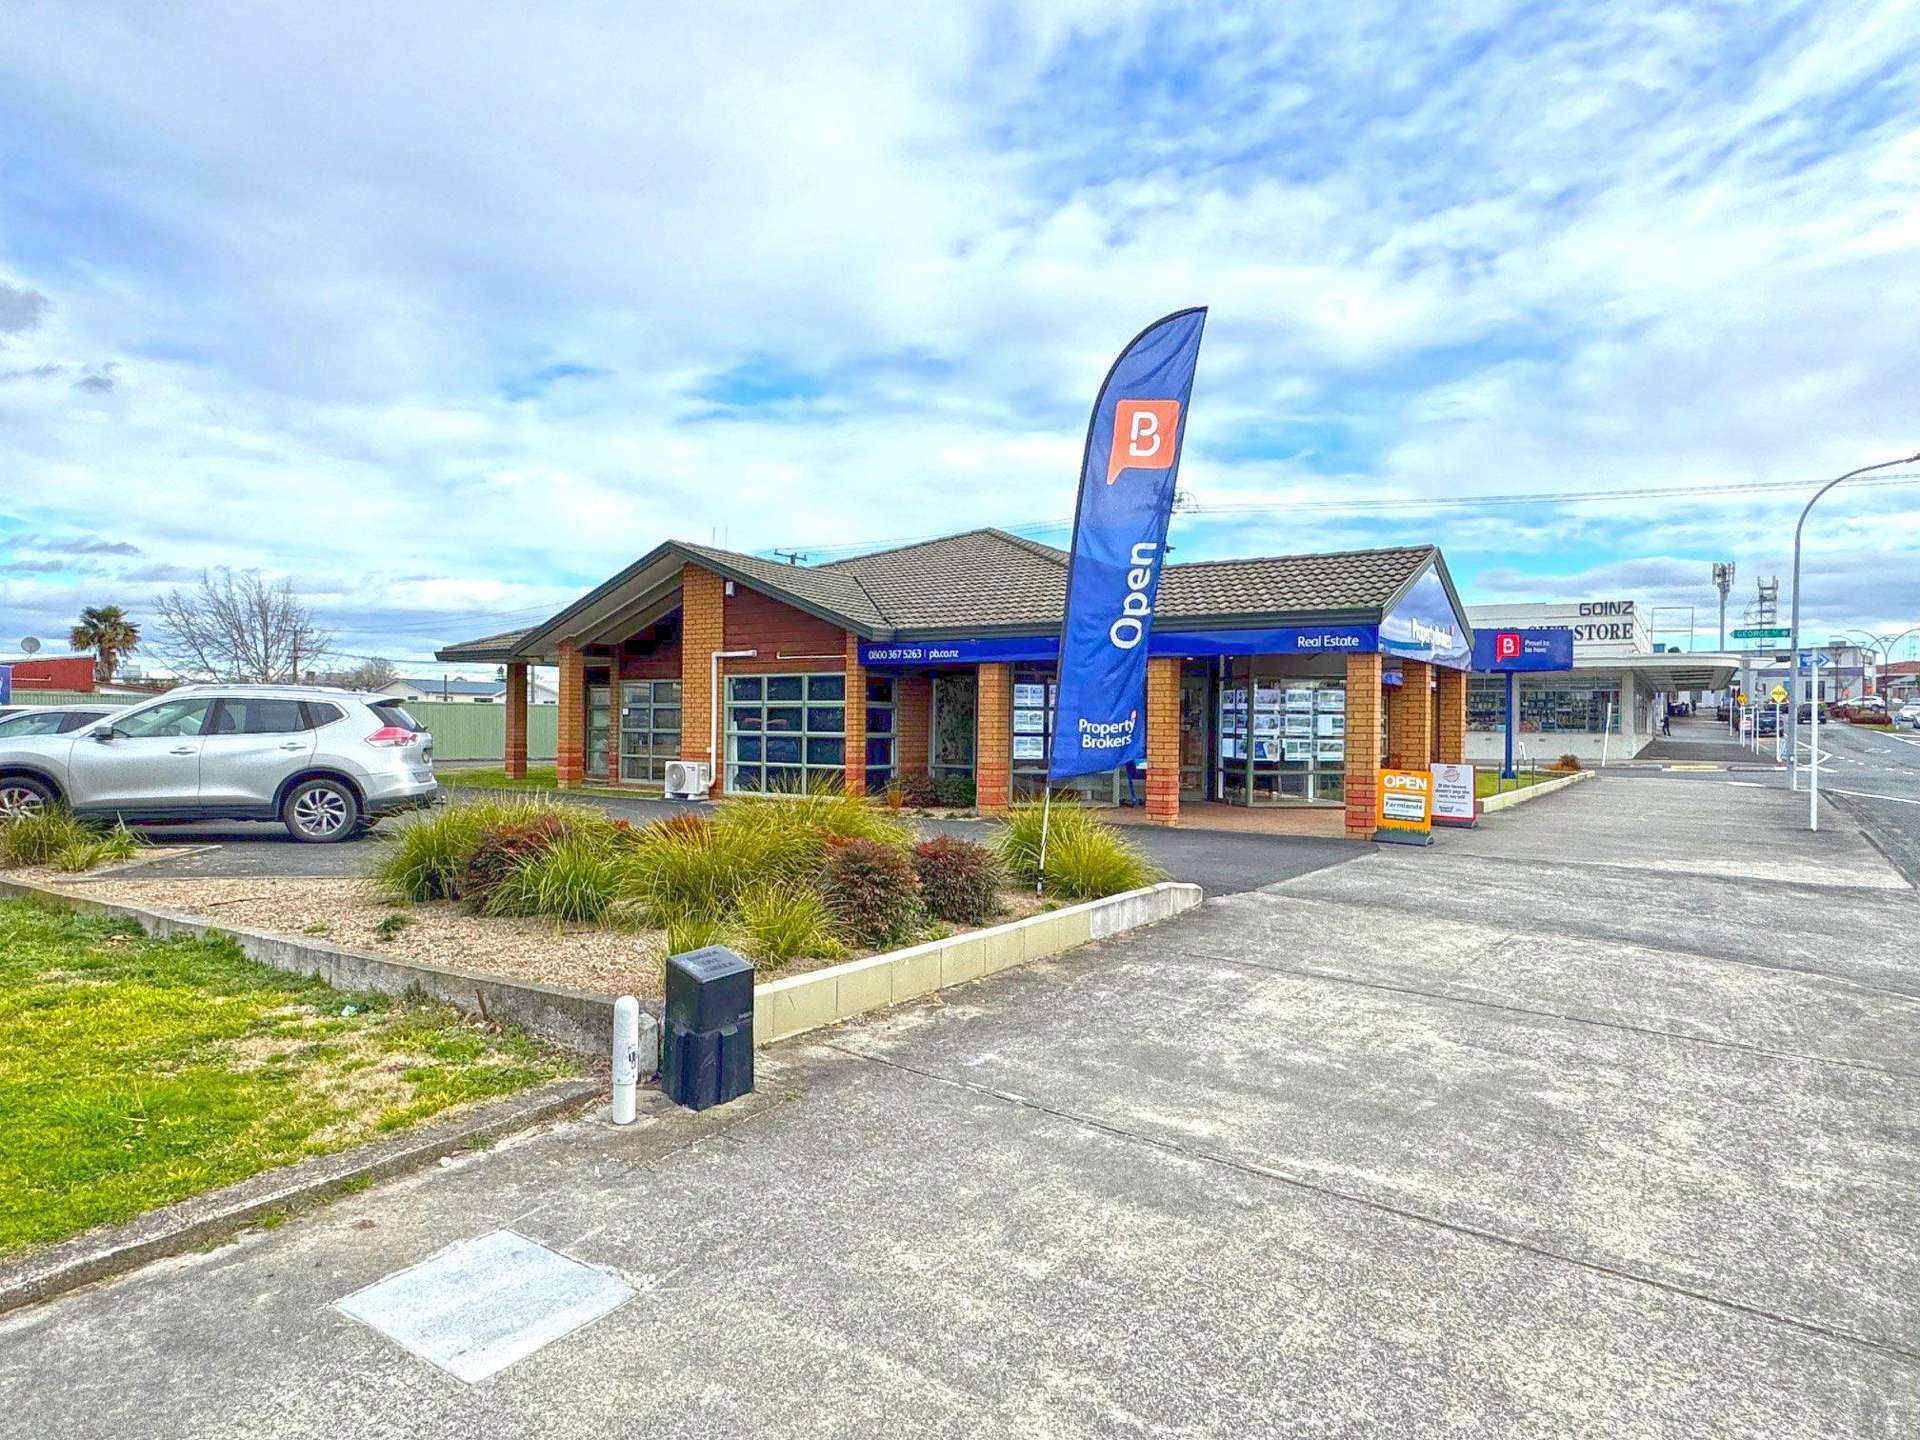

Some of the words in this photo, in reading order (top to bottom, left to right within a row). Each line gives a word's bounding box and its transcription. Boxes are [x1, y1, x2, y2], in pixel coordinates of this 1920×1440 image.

[1110, 542, 1158, 651] Open
[1579, 601, 1634, 616] GOINZ
[1574, 623, 1634, 642] STORE
[1297, 635, 1322, 648] Real
[1324, 635, 1360, 647] Estate
[868, 650, 888, 660] 0800
[888, 649, 902, 659] 367
[903, 648, 922, 659] 5263
[929, 648, 959, 660] pb.co.nz
[1078, 718, 1136, 739] Property
[1082, 732, 1132, 750] Brokers
[1384, 775, 1427, 790] OPEN
[1385, 801, 1423, 810] Farmlands
